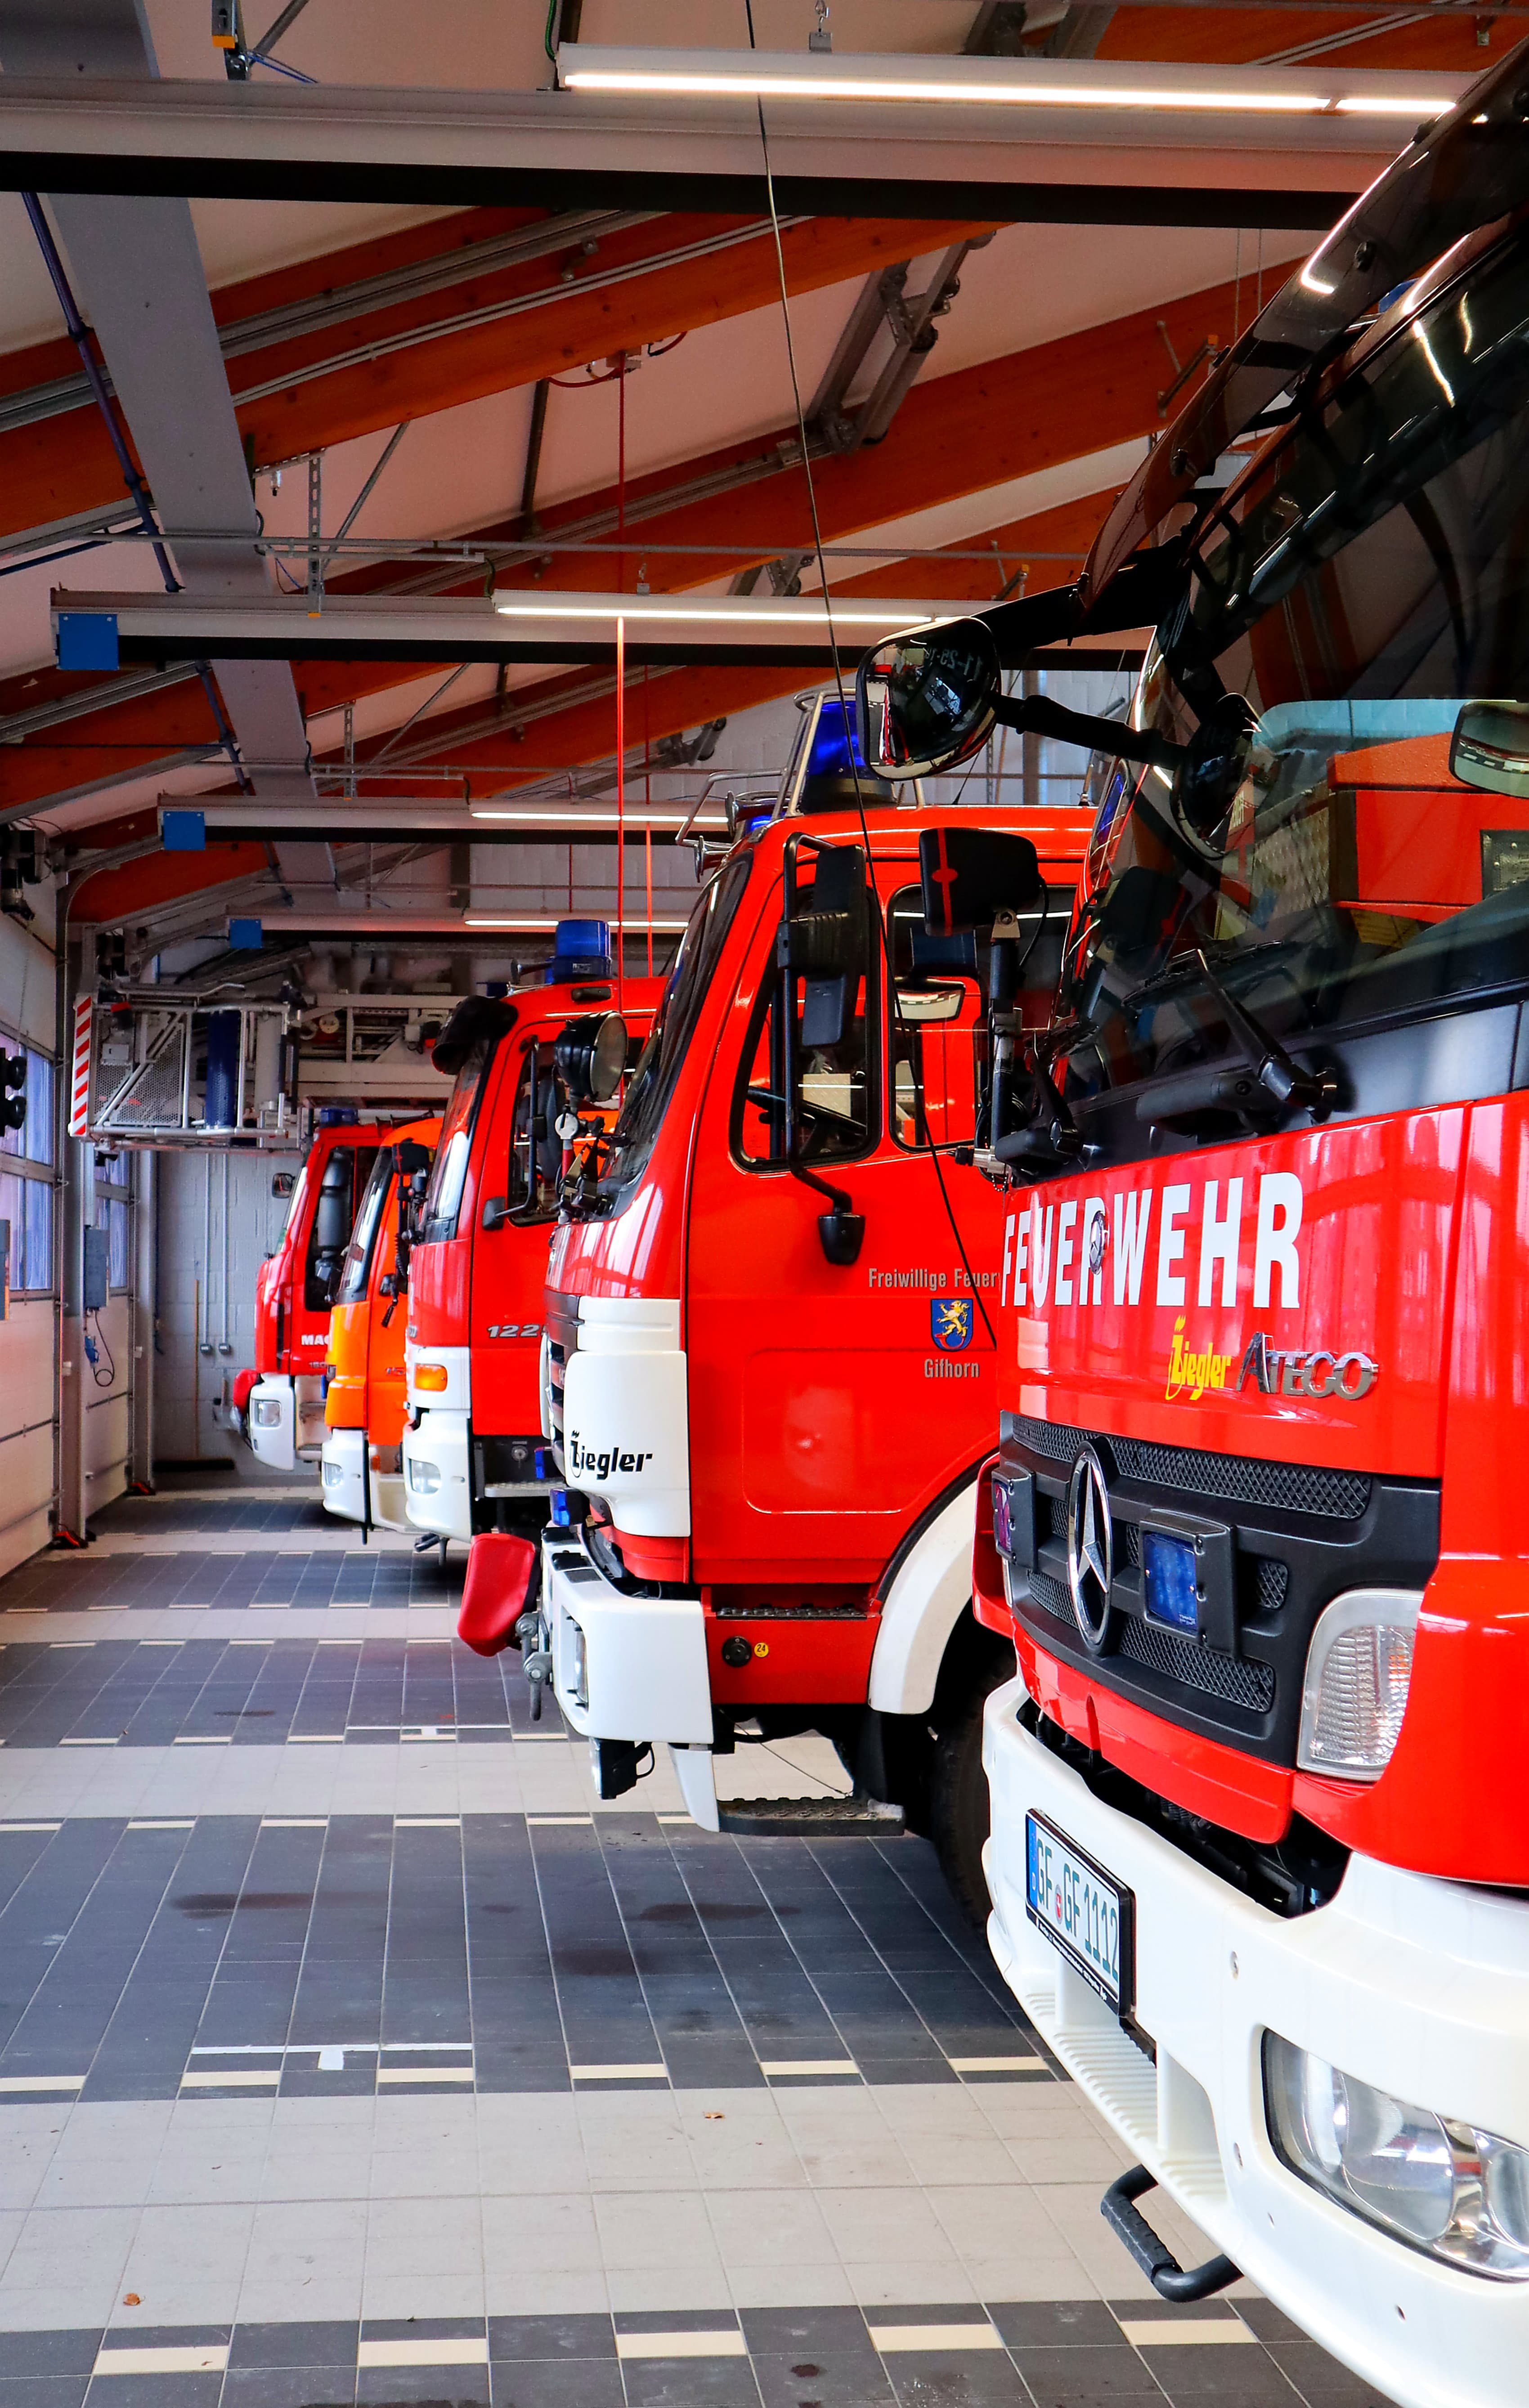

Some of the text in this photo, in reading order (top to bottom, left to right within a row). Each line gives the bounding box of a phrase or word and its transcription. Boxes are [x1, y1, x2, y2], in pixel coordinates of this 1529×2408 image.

[1001, 1171, 1304, 1308] FEUERWEHR
[869, 1268, 1000, 1291] Freiwillige Feuer
[924, 1358, 980, 1378] Gifhorn
[1166, 1322, 1378, 1401] Ziegler ATEGO
[569, 1436, 653, 1480] Ziegler
[757, 1644, 766, 1652] 24
[1037, 1838, 1119, 1983] GF GF 1112
